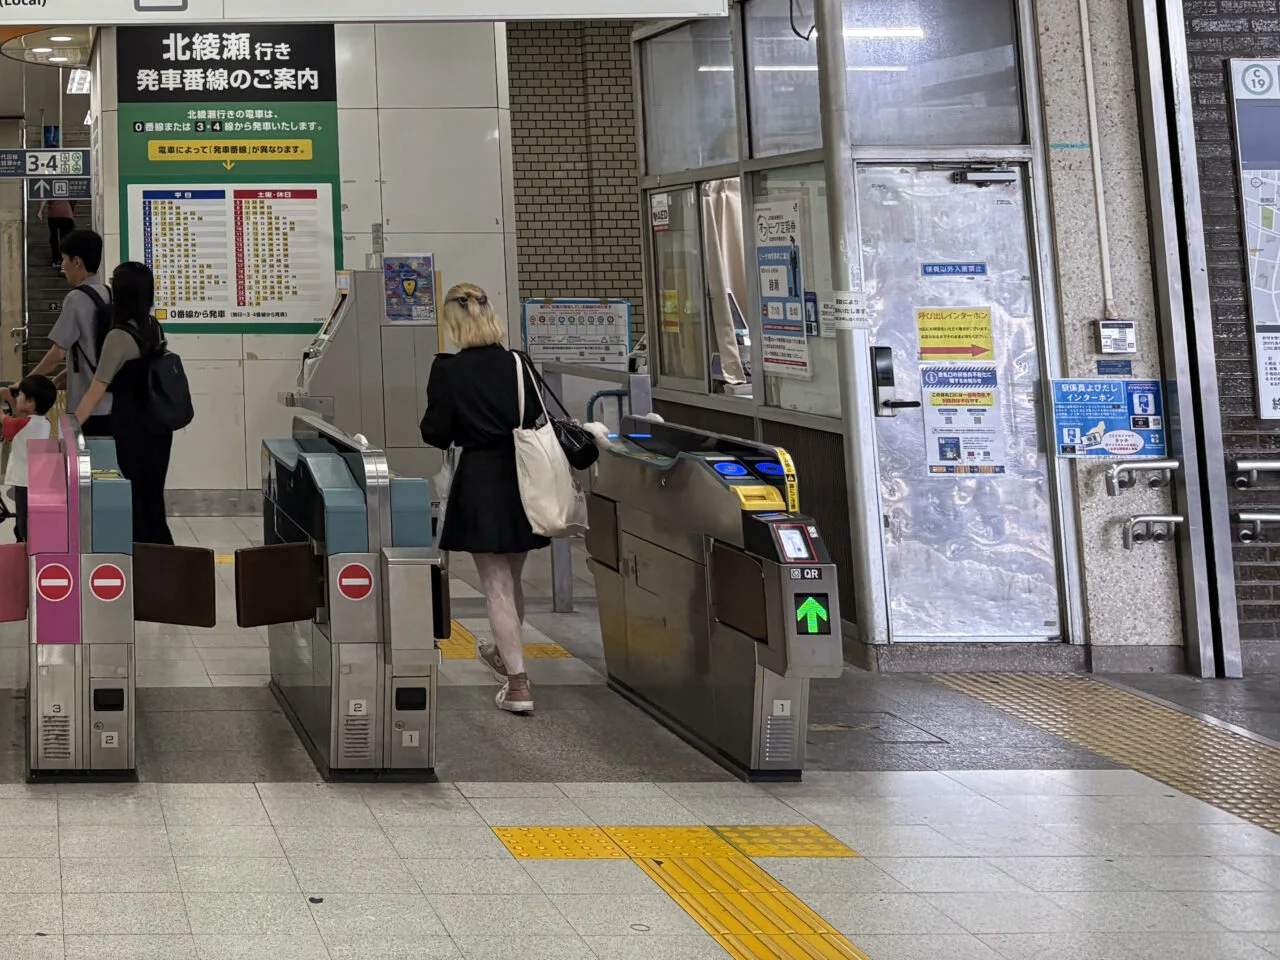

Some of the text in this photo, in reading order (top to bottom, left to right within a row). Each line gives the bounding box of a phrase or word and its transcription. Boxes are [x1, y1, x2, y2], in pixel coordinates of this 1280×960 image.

[162, 32, 291, 61] 北綾瀬 行き
[1253, 69, 1260, 78] C
[136, 68, 319, 91] 発車番線のご案内
[1251, 79, 1266, 89] 19
[657, 210, 668, 220] AED
[170, 310, 226, 319] 0番線から発車
[1067, 394, 1115, 402] インターホン
[804, 569, 819, 578] QR
[52, 704, 61, 713] 3
[353, 703, 362, 712] 2
[105, 735, 114, 744] 2
